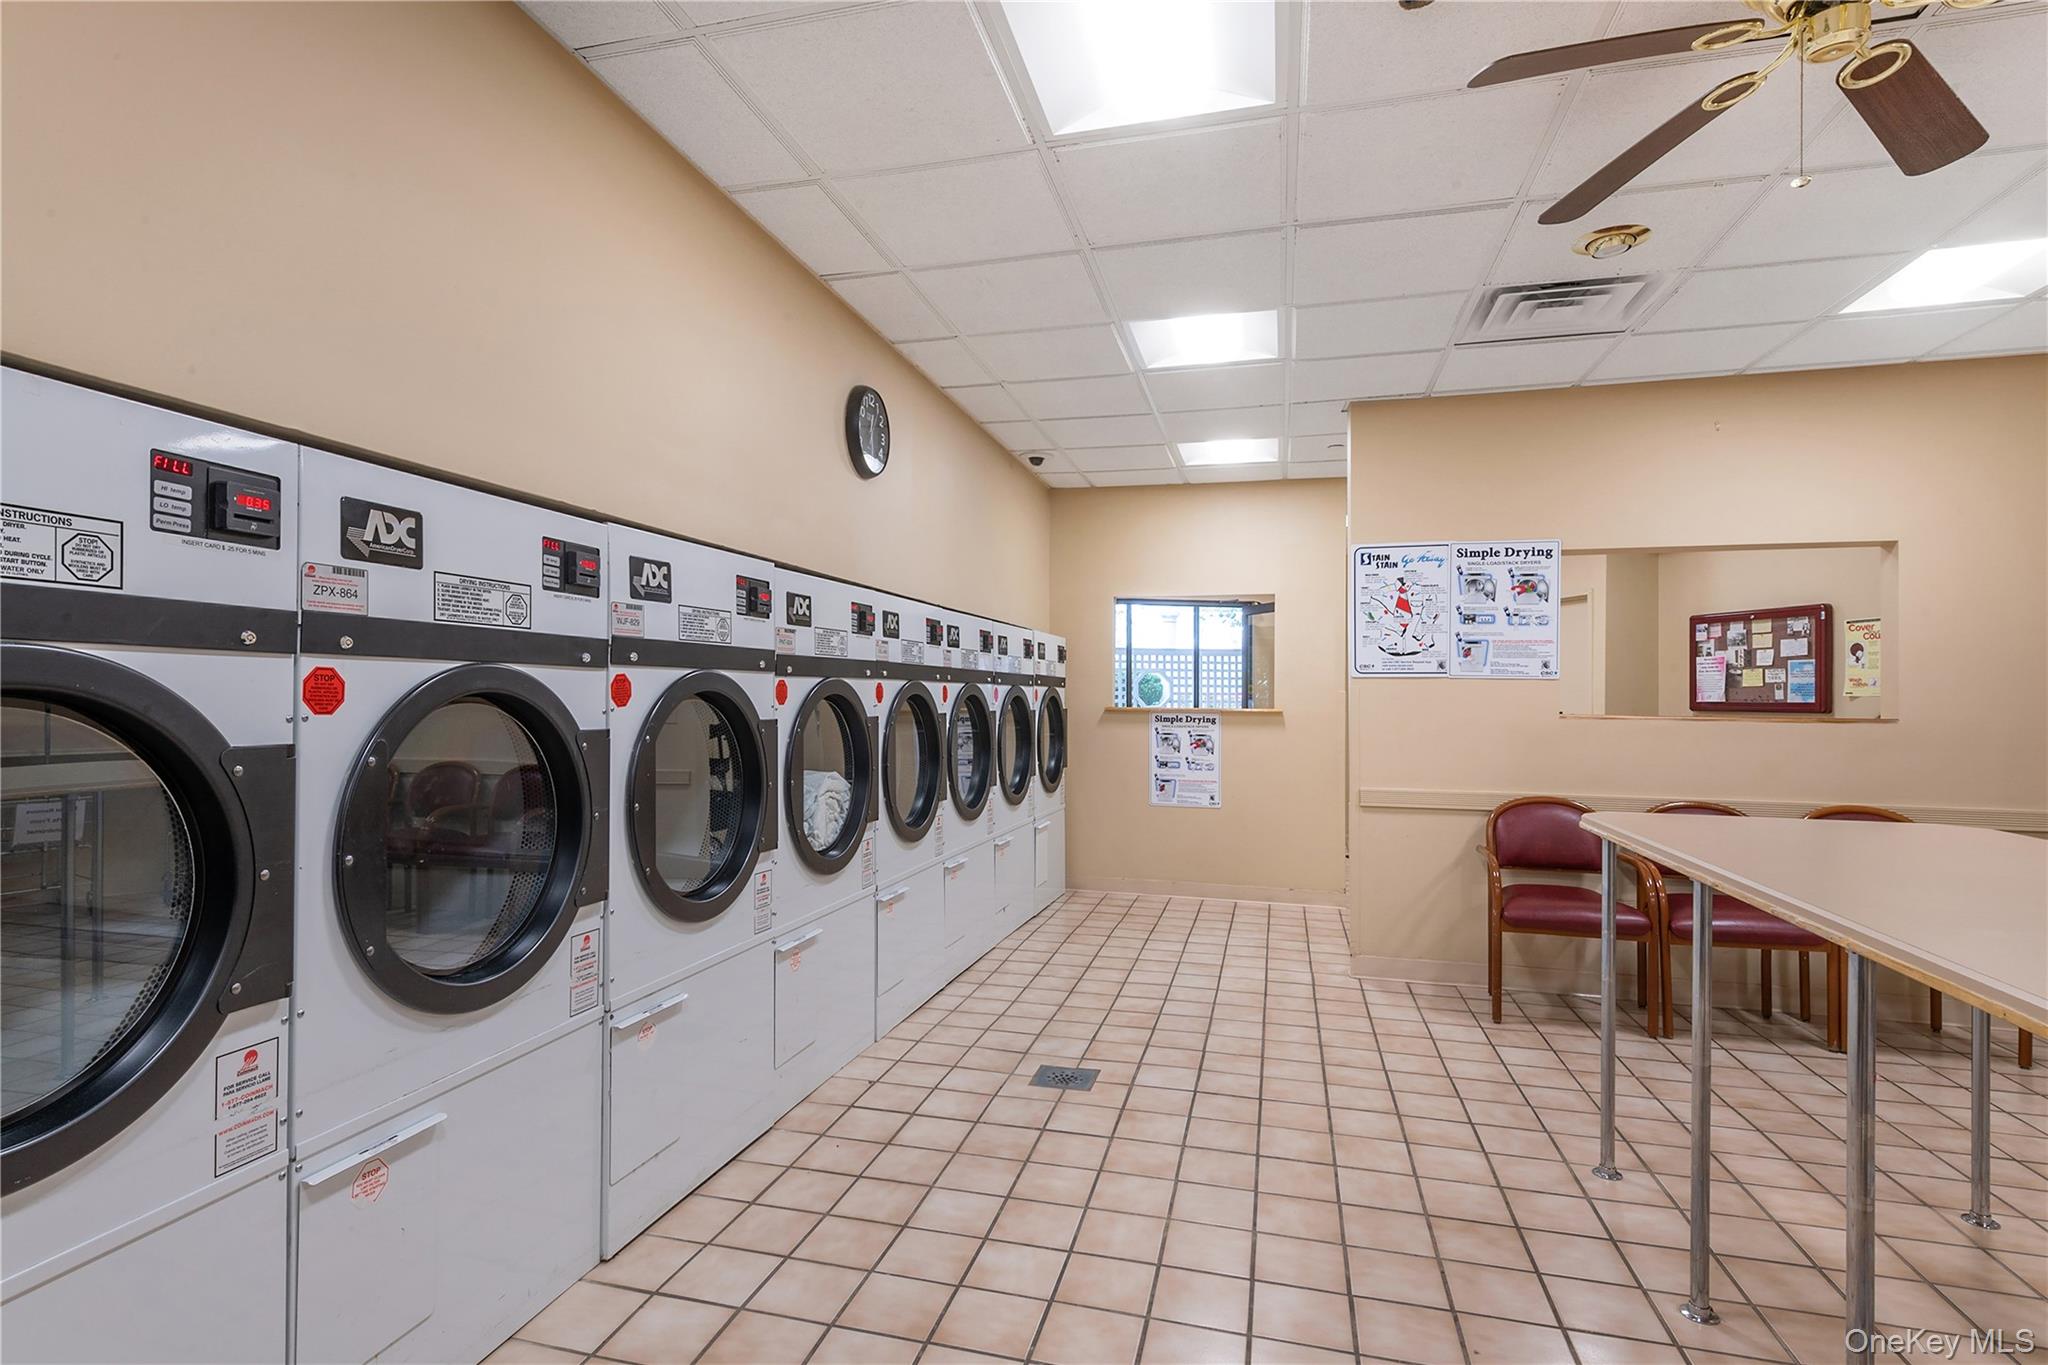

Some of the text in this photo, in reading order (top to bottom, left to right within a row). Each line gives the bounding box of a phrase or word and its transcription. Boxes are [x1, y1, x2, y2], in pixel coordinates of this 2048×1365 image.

[153, 455, 190, 475] FILL
[363, 509, 416, 549] ADC
[1456, 546, 1553, 560] Simple Drying
[1376, 561, 1398, 569] STAIN
[641, 563, 668, 588] ADC
[313, 584, 358, 599] ZPX-864
[1848, 623, 1875, 632] Cover
[314, 674, 335, 682] STOP
[1154, 714, 1217, 725] Simple Drying
[362, 1166, 382, 1181] STOP
